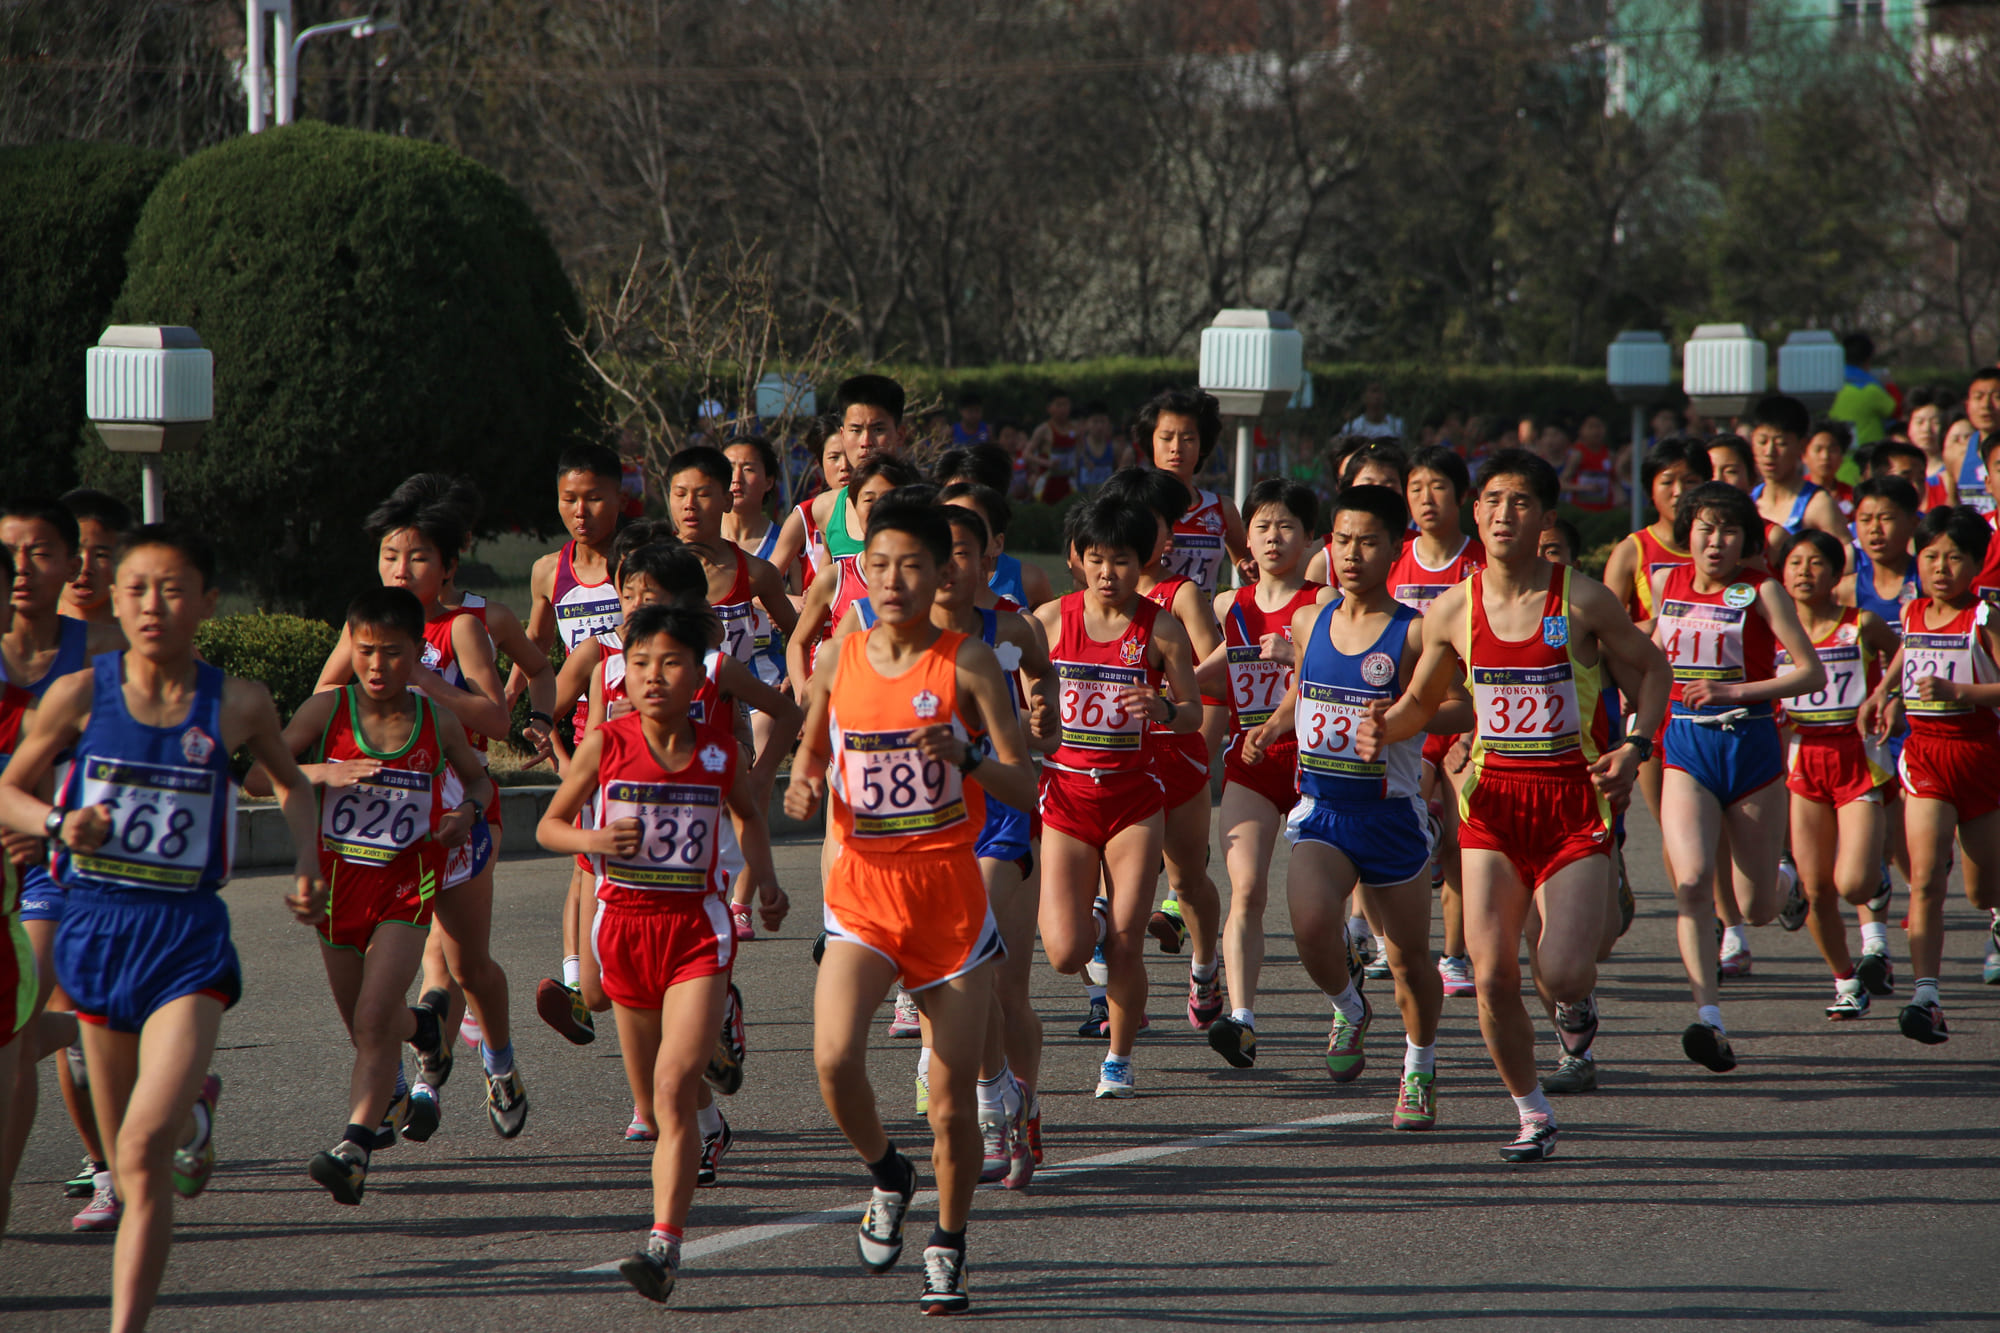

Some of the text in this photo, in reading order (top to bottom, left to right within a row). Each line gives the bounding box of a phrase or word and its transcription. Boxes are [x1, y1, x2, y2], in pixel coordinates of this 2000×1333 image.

[1665, 628, 1725, 666] 411
[1061, 689, 1129, 729] 363
[1493, 685, 1555, 696] PYONGYANG
[1307, 712, 1361, 755] 33
[1489, 695, 1565, 734] 322
[862, 763, 945, 811] 589
[332, 794, 419, 844] 626
